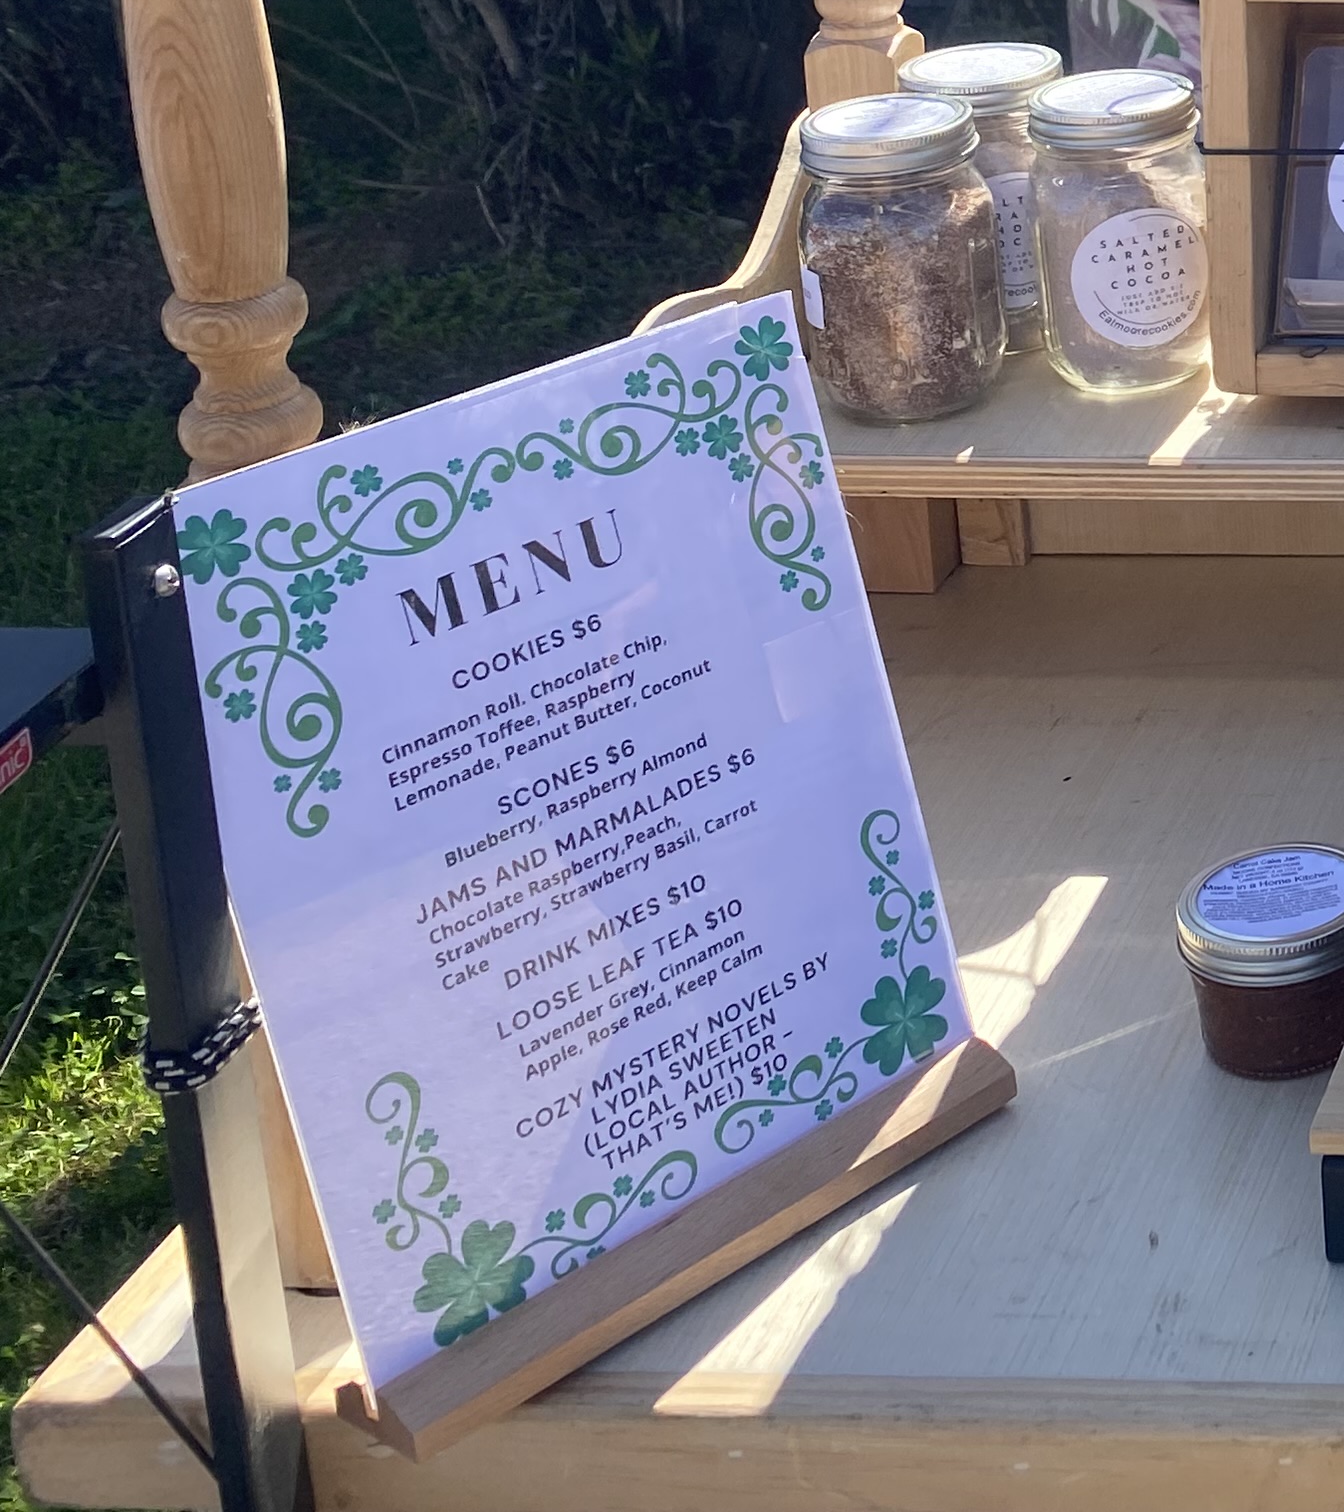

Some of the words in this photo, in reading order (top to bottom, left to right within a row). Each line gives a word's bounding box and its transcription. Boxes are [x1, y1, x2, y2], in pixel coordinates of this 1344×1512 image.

[1091, 236, 1194, 263] CARAMEL
[1100, 225, 1184, 248] SALTED
[1111, 268, 1185, 289] COCOA
[1127, 258, 1167, 273] HOT
[1099, 290, 1200, 335] Eatmoorecookies.com
[396, 509, 623, 646] MENU
[382, 713, 480, 764] Cinnamon
[530, 654, 621, 699] Chocolate
[623, 634, 667, 660] Chip,
[452, 630, 565, 689] COOKIES
[572, 614, 602, 640] $6
[388, 743, 472, 788] Espresso
[477, 714, 541, 749] Toffee,
[545, 669, 637, 719] Raspberry
[394, 758, 500, 812] Lemonade,
[504, 723, 571, 761] Peanut
[575, 697, 637, 729] Butter,
[640, 659, 712, 700] Coconut
[497, 755, 599, 814] SCONES
[606, 740, 635, 765] $6
[416, 877, 487, 925] JAMS
[496, 848, 548, 887] AND
[554, 765, 721, 857] MARMALADES
[726, 748, 756, 775] $6
[444, 815, 543, 867] Blueberry,
[547, 768, 637, 819] Raspberry
[641, 733, 708, 776] Almond
[428, 889, 525, 944] Chocolate
[435, 907, 548, 968] Strawberry,
[550, 853, 650, 911] Strawberry
[654, 828, 701, 860] Basil,
[703, 800, 758, 834] Carrot
[504, 937, 581, 990] DRINK
[587, 898, 661, 947] MIXES
[666, 875, 707, 907] $10
[442, 959, 490, 989] Cake
[496, 982, 583, 1041] LOOSE
[587, 948, 647, 990] LEAF
[652, 923, 699, 957] TEA
[704, 898, 744, 931] $10
[518, 1007, 604, 1058] Lavender
[609, 979, 654, 1009] Grey,
[658, 930, 745, 982] Cinnamon
[526, 1044, 583, 1082] Apple,
[587, 1017, 630, 1046] Rose
[633, 996, 672, 1022] Red,
[675, 970, 718, 1000] Keep
[721, 943, 763, 974] Calm
[516, 1087, 583, 1139] COZY
[591, 1022, 702, 1098] MYSTERY
[707, 972, 797, 1034] NOVELS
[801, 952, 831, 982] BY
[584, 1096, 676, 1157] (LOCAL
[684, 1034, 777, 1101] AUTHOR
[591, 1076, 663, 1124] LYDIA
[668, 1008, 777, 1081] SWEETEN
[602, 1115, 687, 1170] THAT'S
[695, 1081, 745, 1119] ME!)
[750, 1054, 788, 1085] $10
